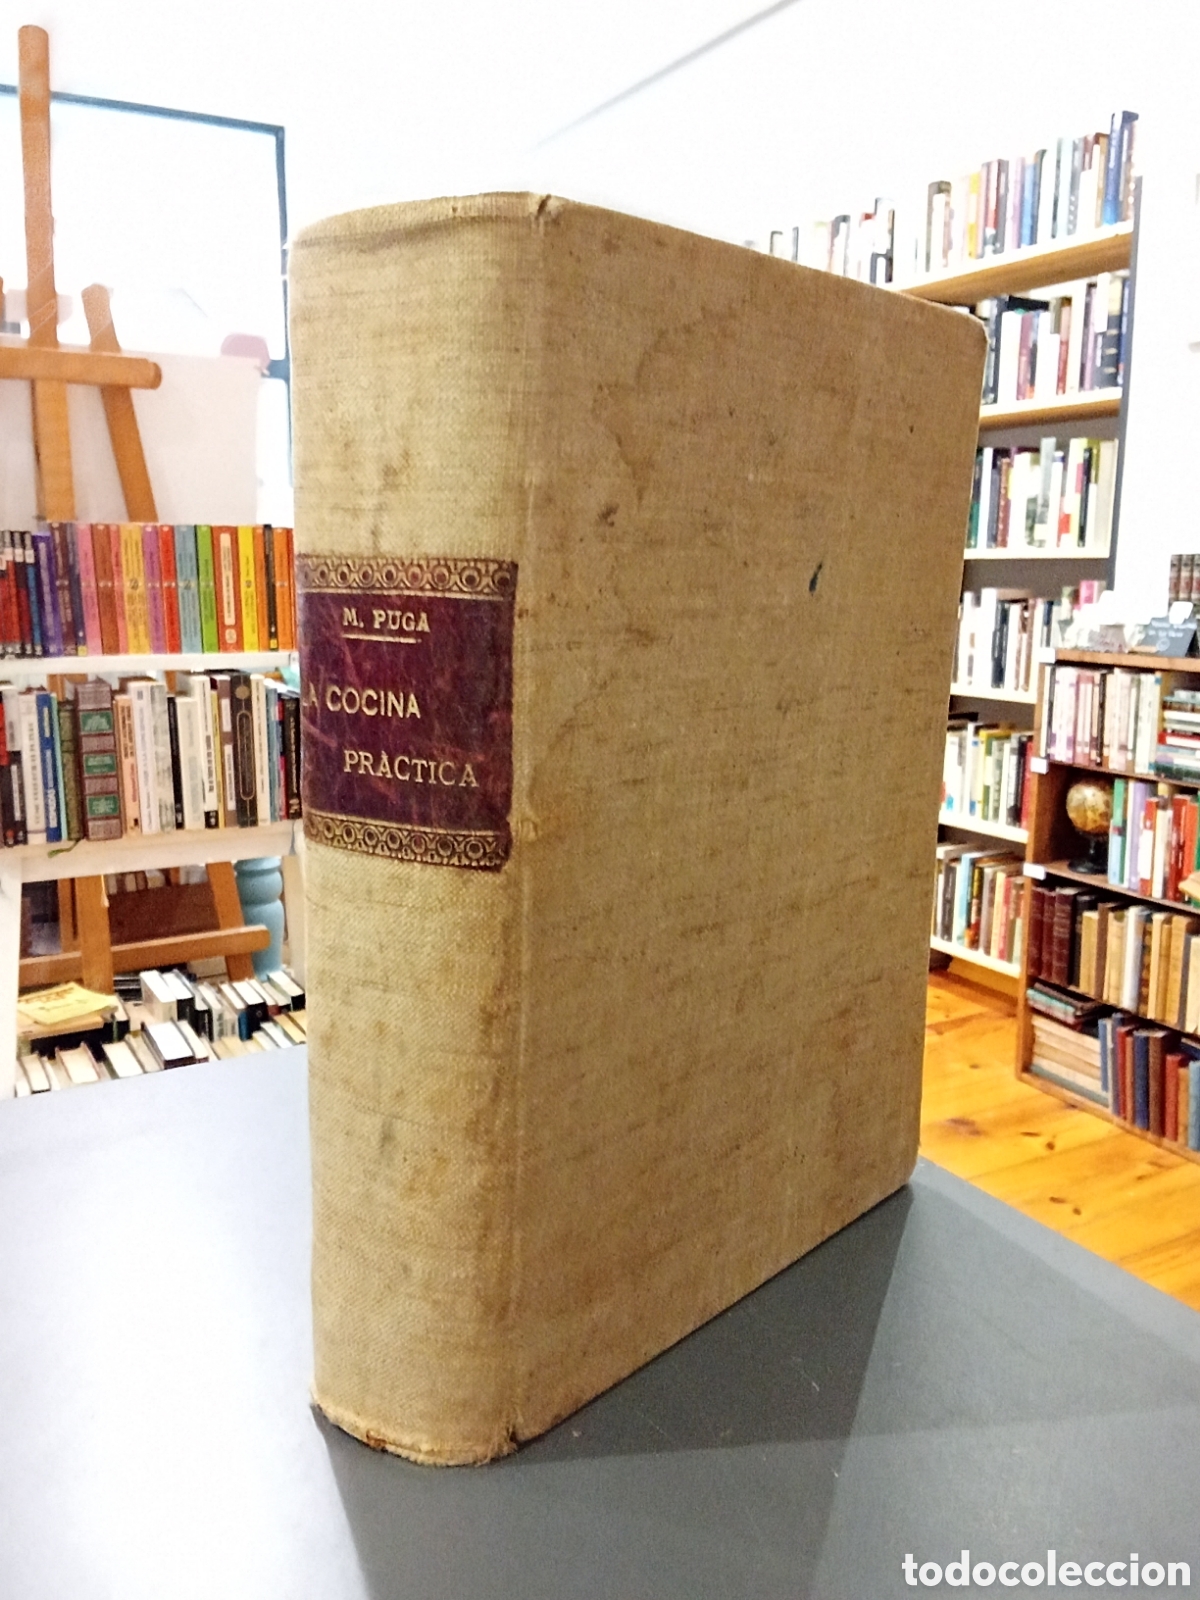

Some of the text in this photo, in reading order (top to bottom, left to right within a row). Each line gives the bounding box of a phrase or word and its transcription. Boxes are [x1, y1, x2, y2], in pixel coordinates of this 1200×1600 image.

[342, 607, 431, 632] M. PUGA
[326, 685, 421, 719] COCINA
